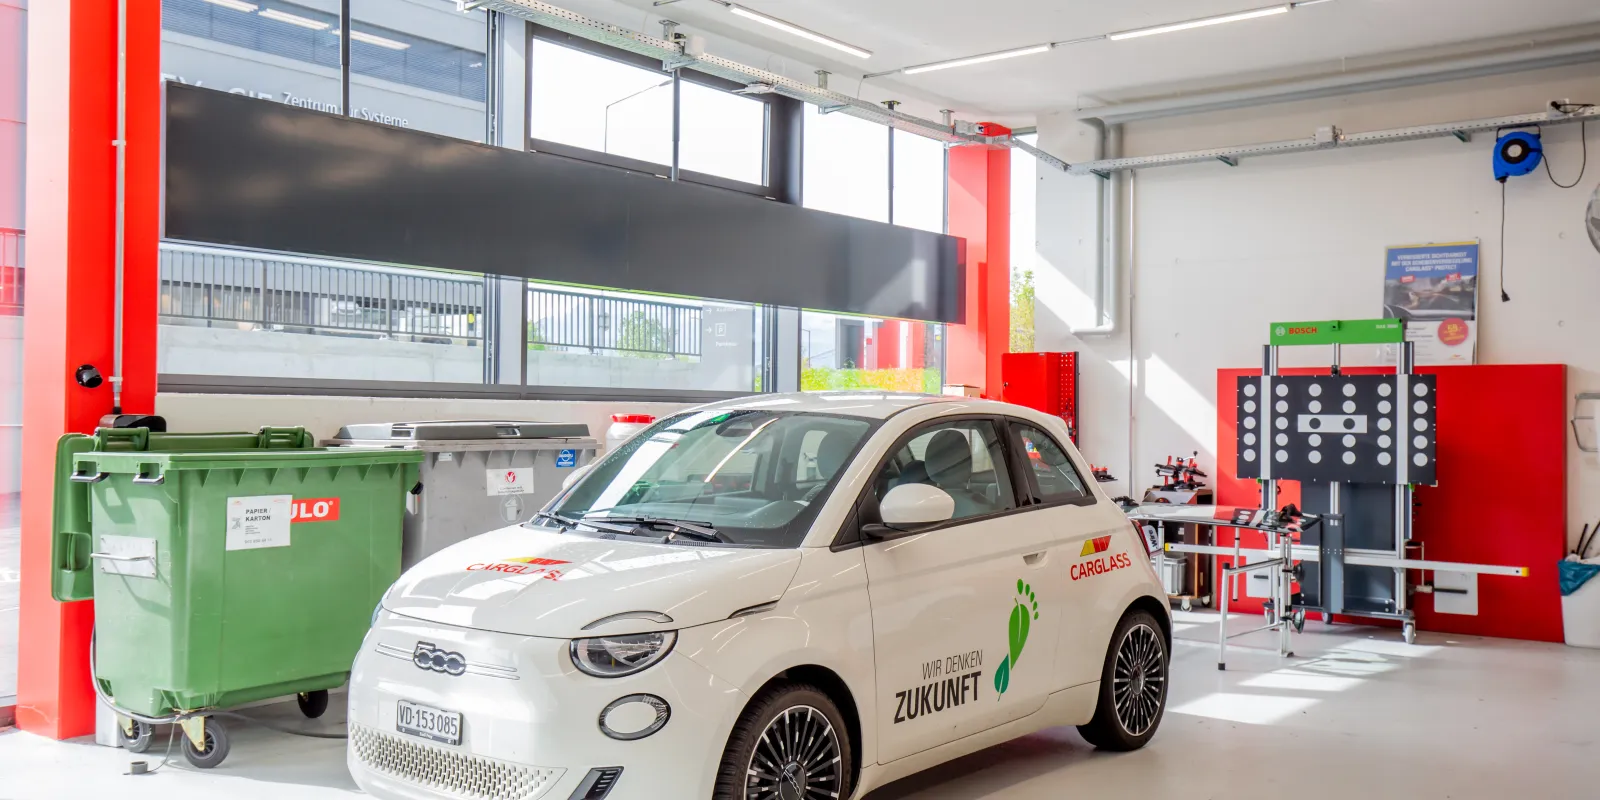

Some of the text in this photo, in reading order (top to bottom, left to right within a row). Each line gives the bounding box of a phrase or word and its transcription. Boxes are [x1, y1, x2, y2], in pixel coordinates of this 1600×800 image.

[283, 92, 338, 115] Zentrum
[1070, 552, 1132, 581] CARGLASS
[413, 640, 467, 676] 500
[922, 649, 983, 681] WIR DENKEN
[893, 670, 982, 724] ZUKUNFT
